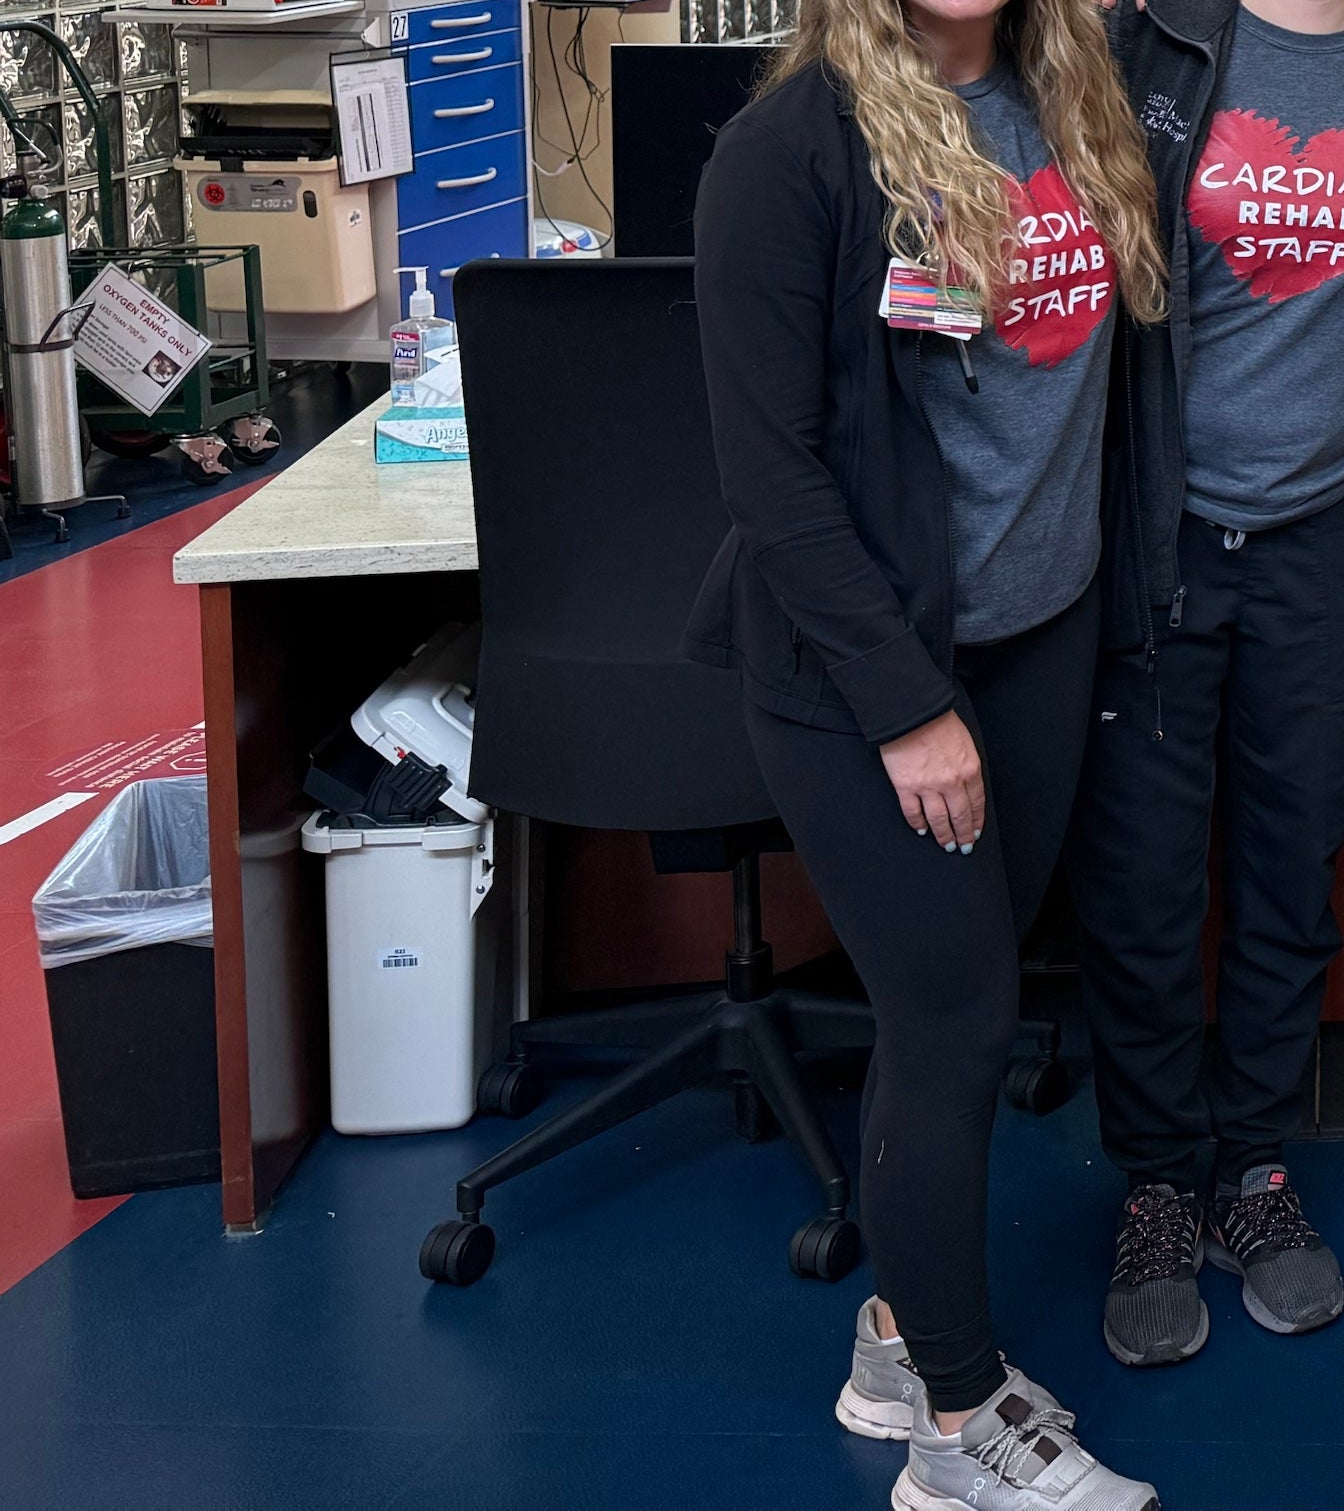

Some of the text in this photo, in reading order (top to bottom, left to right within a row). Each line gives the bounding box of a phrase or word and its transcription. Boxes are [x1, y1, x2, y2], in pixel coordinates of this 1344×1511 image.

[392, 15, 407, 38] 27
[1009, 245, 1105, 284] REHAB
[99, 304, 112, 317] LESS
[112, 312, 127, 327] THAN
[126, 323, 139, 336] 700
[139, 299, 170, 324] EMPTY
[1004, 282, 1109, 326] STAFF
[103, 284, 140, 315] OXYGEN
[139, 310, 168, 338] TANKS
[167, 336, 193, 357] ONLY
[425, 426, 467, 444] Ange
